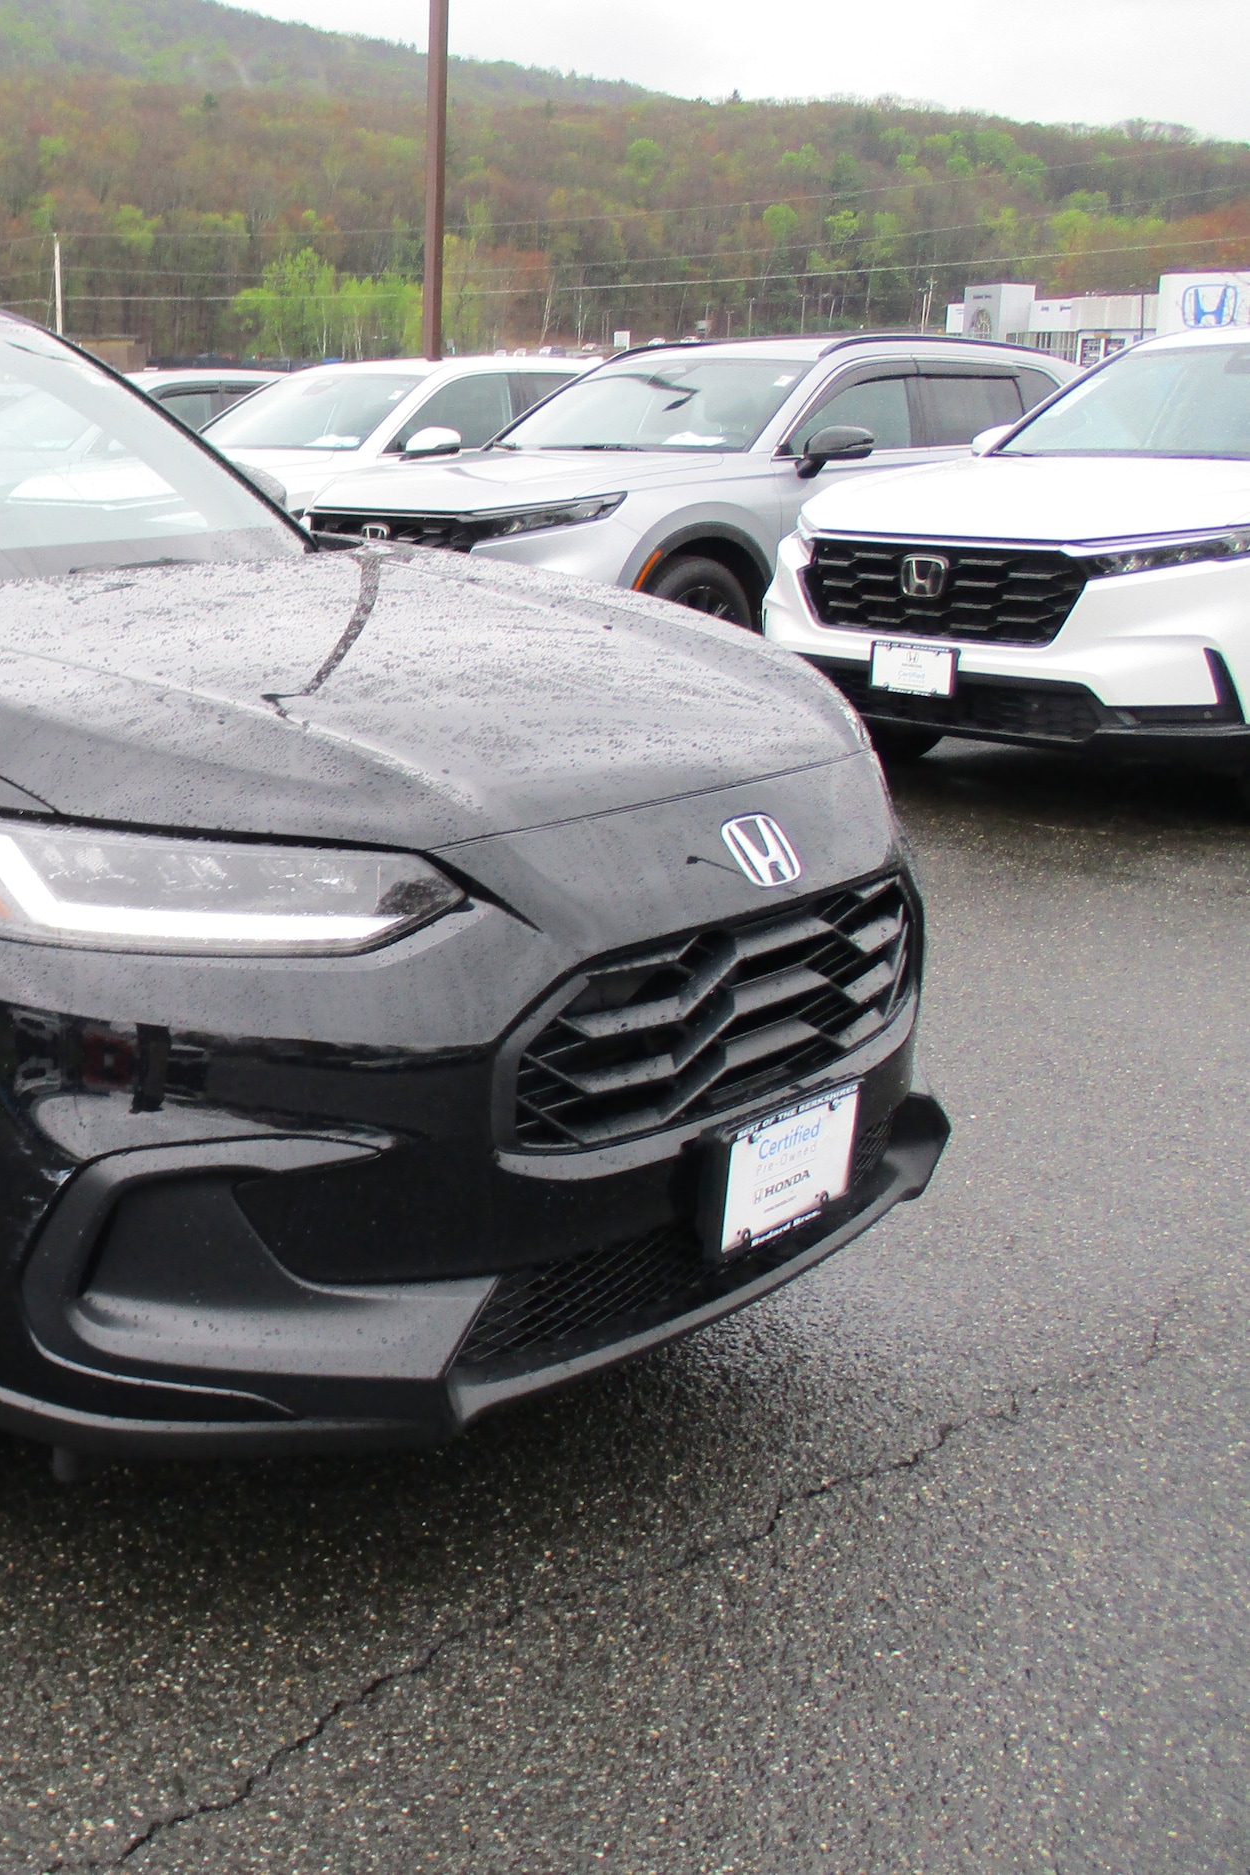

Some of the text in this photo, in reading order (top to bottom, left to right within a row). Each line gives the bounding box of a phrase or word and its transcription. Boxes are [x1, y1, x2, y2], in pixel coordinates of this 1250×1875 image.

[761, 1115, 777, 1128] OF
[777, 1107, 798, 1120] THE
[758, 1116, 823, 1160] Certified
[755, 1142, 818, 1176] Pre-Owned
[764, 1169, 811, 1199] HONDA
